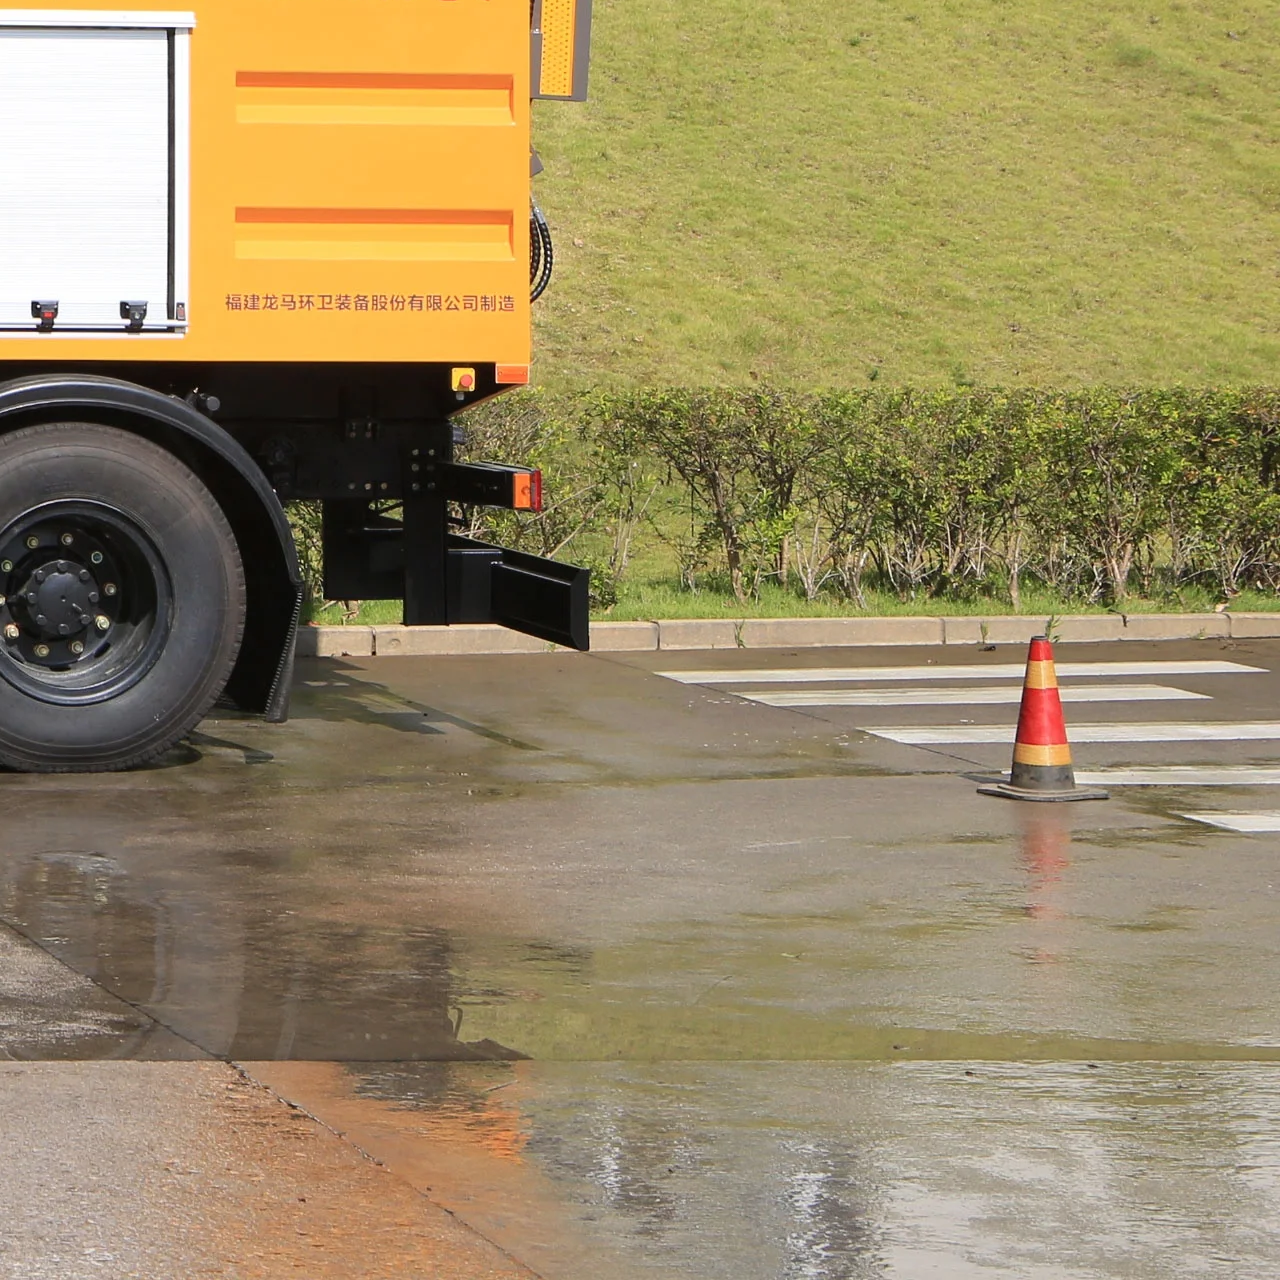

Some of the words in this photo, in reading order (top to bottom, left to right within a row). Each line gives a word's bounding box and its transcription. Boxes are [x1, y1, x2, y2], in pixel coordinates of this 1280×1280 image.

[224, 293, 516, 312] 福建龙马环卫装备股份有限公司制造
